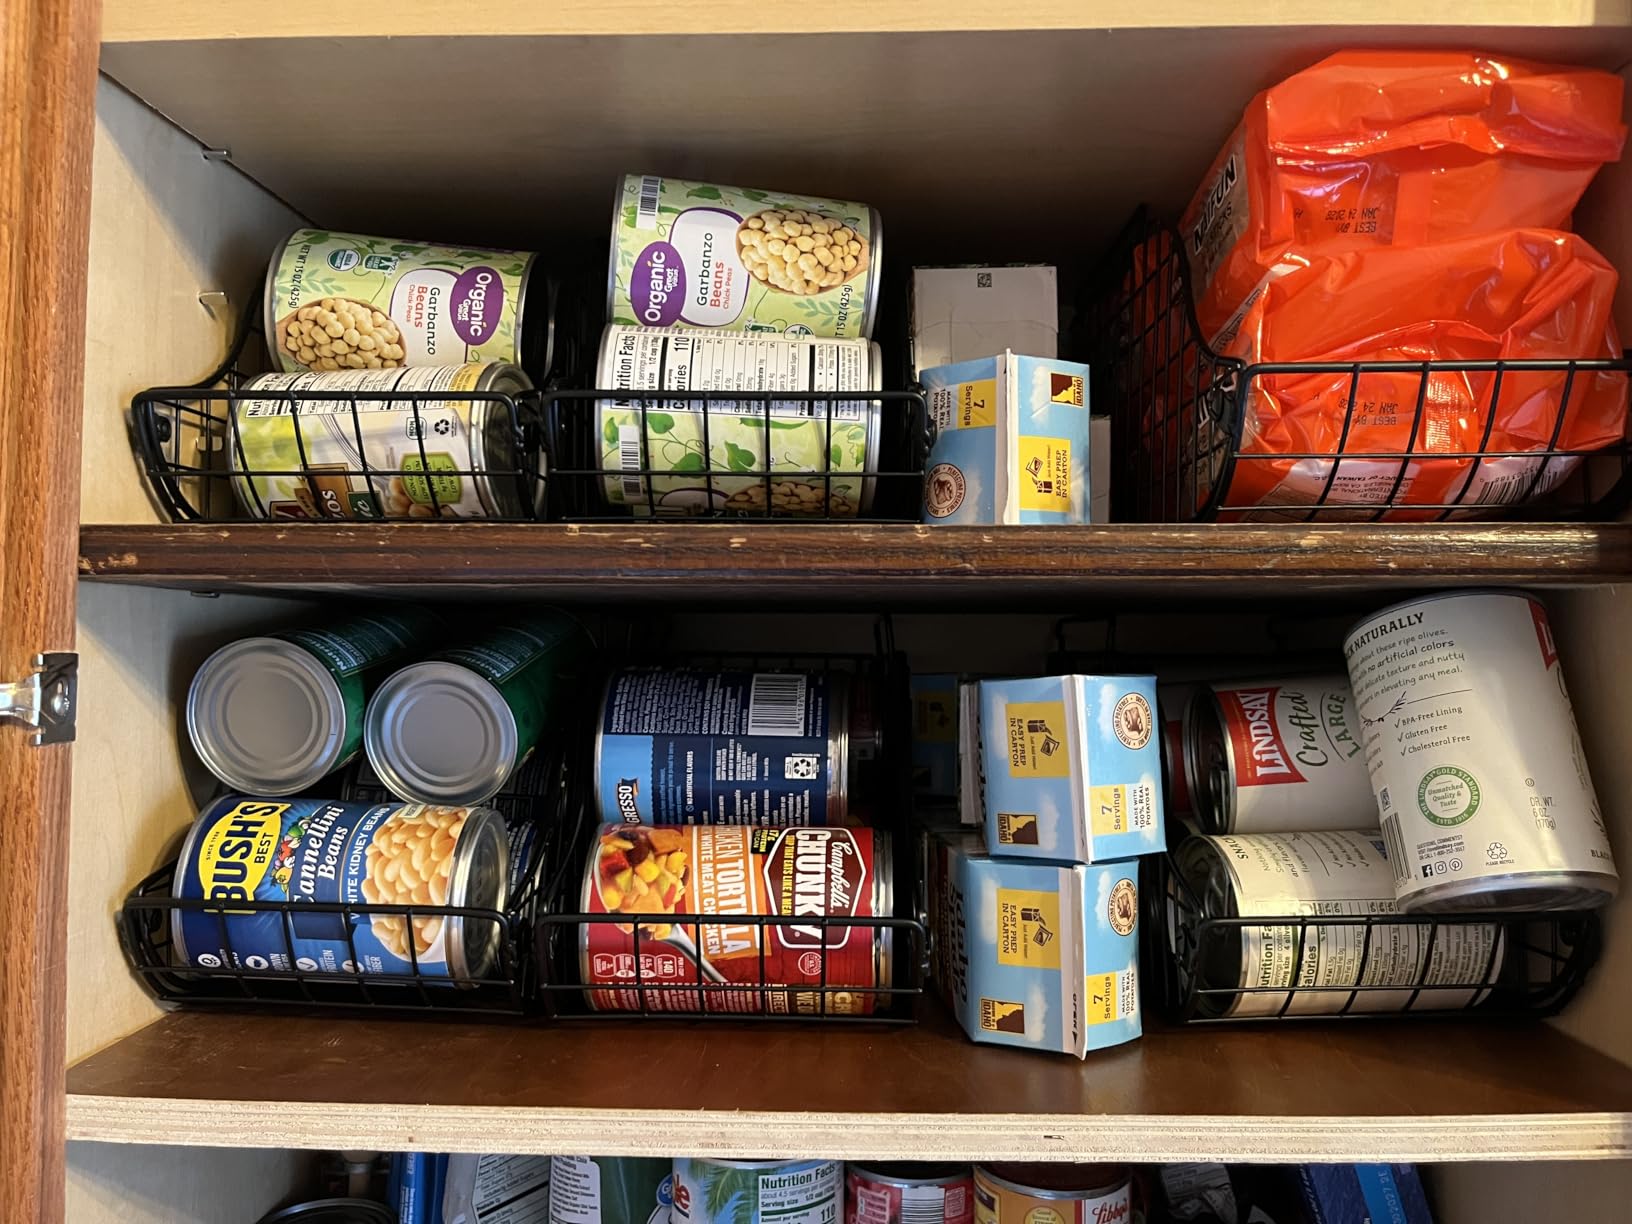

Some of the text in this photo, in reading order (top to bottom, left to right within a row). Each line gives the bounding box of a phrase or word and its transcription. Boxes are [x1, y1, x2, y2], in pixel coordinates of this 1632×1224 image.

[1361, 208, 1380, 220] JAN
[1353, 221, 1376, 233] BEST
[294, 265, 304, 274] 15
[296, 254, 306, 264] WT
[696, 232, 713, 307] Garbanzo
[645, 250, 667, 322] Organic
[664, 268, 675, 292] Great
[710, 261, 724, 308] Beans
[723, 268, 733, 309] Chick Peas
[288, 284, 301, 309] (425g)
[405, 284, 415, 323] Chick Peas
[413, 286, 428, 328] Beans
[469, 272, 492, 338] Organic
[836, 320, 844, 330] 15
[841, 284, 854, 309] (425g)
[427, 287, 440, 355] Garbanzo
[461, 299, 472, 321] Great
[619, 336, 635, 356] Facts
[674, 337, 690, 352] 110
[647, 372, 656, 383] size
[974, 400, 985, 408] 7
[1075, 379, 1083, 404] IDAHO
[963, 386, 973, 426] Servings
[1363, 402, 1399, 414] JAN 24
[1355, 415, 1397, 426] BEST BY
[405, 465, 417, 497] NON-GO
[1061, 489, 1068, 498] IN
[1354, 611, 1425, 651] NATURALLY
[1376, 628, 1449, 655] these ripe olives.
[1367, 639, 1455, 673] no artificial colors
[1386, 662, 1416, 678] texture
[1418, 655, 1435, 668] and
[1437, 651, 1465, 663] nutty
[1380, 676, 1416, 695] elevating
[1418, 671, 1436, 683] any
[1437, 665, 1463, 678] meal.
[1113, 698, 1131, 746] PERFECTING POTATOES
[1327, 694, 1360, 758] LARGE
[1402, 706, 1463, 726] BPA-Free Lining
[1280, 691, 1328, 767] Crafted
[1404, 723, 1448, 740] Gluten Free
[1009, 718, 1020, 767] IN CARTON
[1016, 719, 1027, 766] EASY PREP
[1408, 734, 1471, 754] Cholesterol Free
[1428, 782, 1464, 796] Unmatched
[1432, 792, 1456, 803] Quality
[1436, 768, 1457, 776] GOLD
[1458, 771, 1479, 806] STANDARD
[1101, 805, 1113, 815] 7
[1113, 787, 1121, 830] Servings
[1439, 799, 1457, 808] Taste
[1532, 807, 1538, 818] 6
[1000, 816, 1008, 841] IDAHO
[1535, 817, 1556, 831] (170g)
[210, 804, 280, 901] BUSH'S
[253, 832, 273, 864] BEST
[317, 826, 348, 881] Beans
[348, 832, 368, 875] KIDNEY
[362, 807, 390, 832] BEANS
[784, 846, 794, 859] THAT
[1224, 836, 1249, 860] SNAC
[783, 860, 794, 875] EATS
[827, 841, 852, 909] Campbell's
[1286, 863, 1299, 878] and
[701, 833, 720, 955] WHITE MEAT CHCKEN
[782, 875, 793, 891] LIKE
[717, 859, 751, 954] TORTILA
[1002, 903, 1009, 913] IN
[1334, 903, 1340, 913] 0%
[1283, 926, 1291, 944] olive
[663, 960, 673, 974] 140
[1260, 943, 1273, 986] utrition
[1283, 956, 1291, 969] size
[1303, 945, 1317, 987] alories
[1093, 995, 1103, 1004] 7
[983, 1000, 992, 1027] IDAHO
[761, 1162, 836, 1190] Nutrition Facts
[761, 1199, 785, 1208] Serving
[788, 1198, 799, 1206] size
[778, 1190, 787, 1198] 4.5
[761, 1215, 779, 1224] Amount
[820, 1202, 836, 1221] 110
[1092, 1197, 1128, 1224] Libby's
